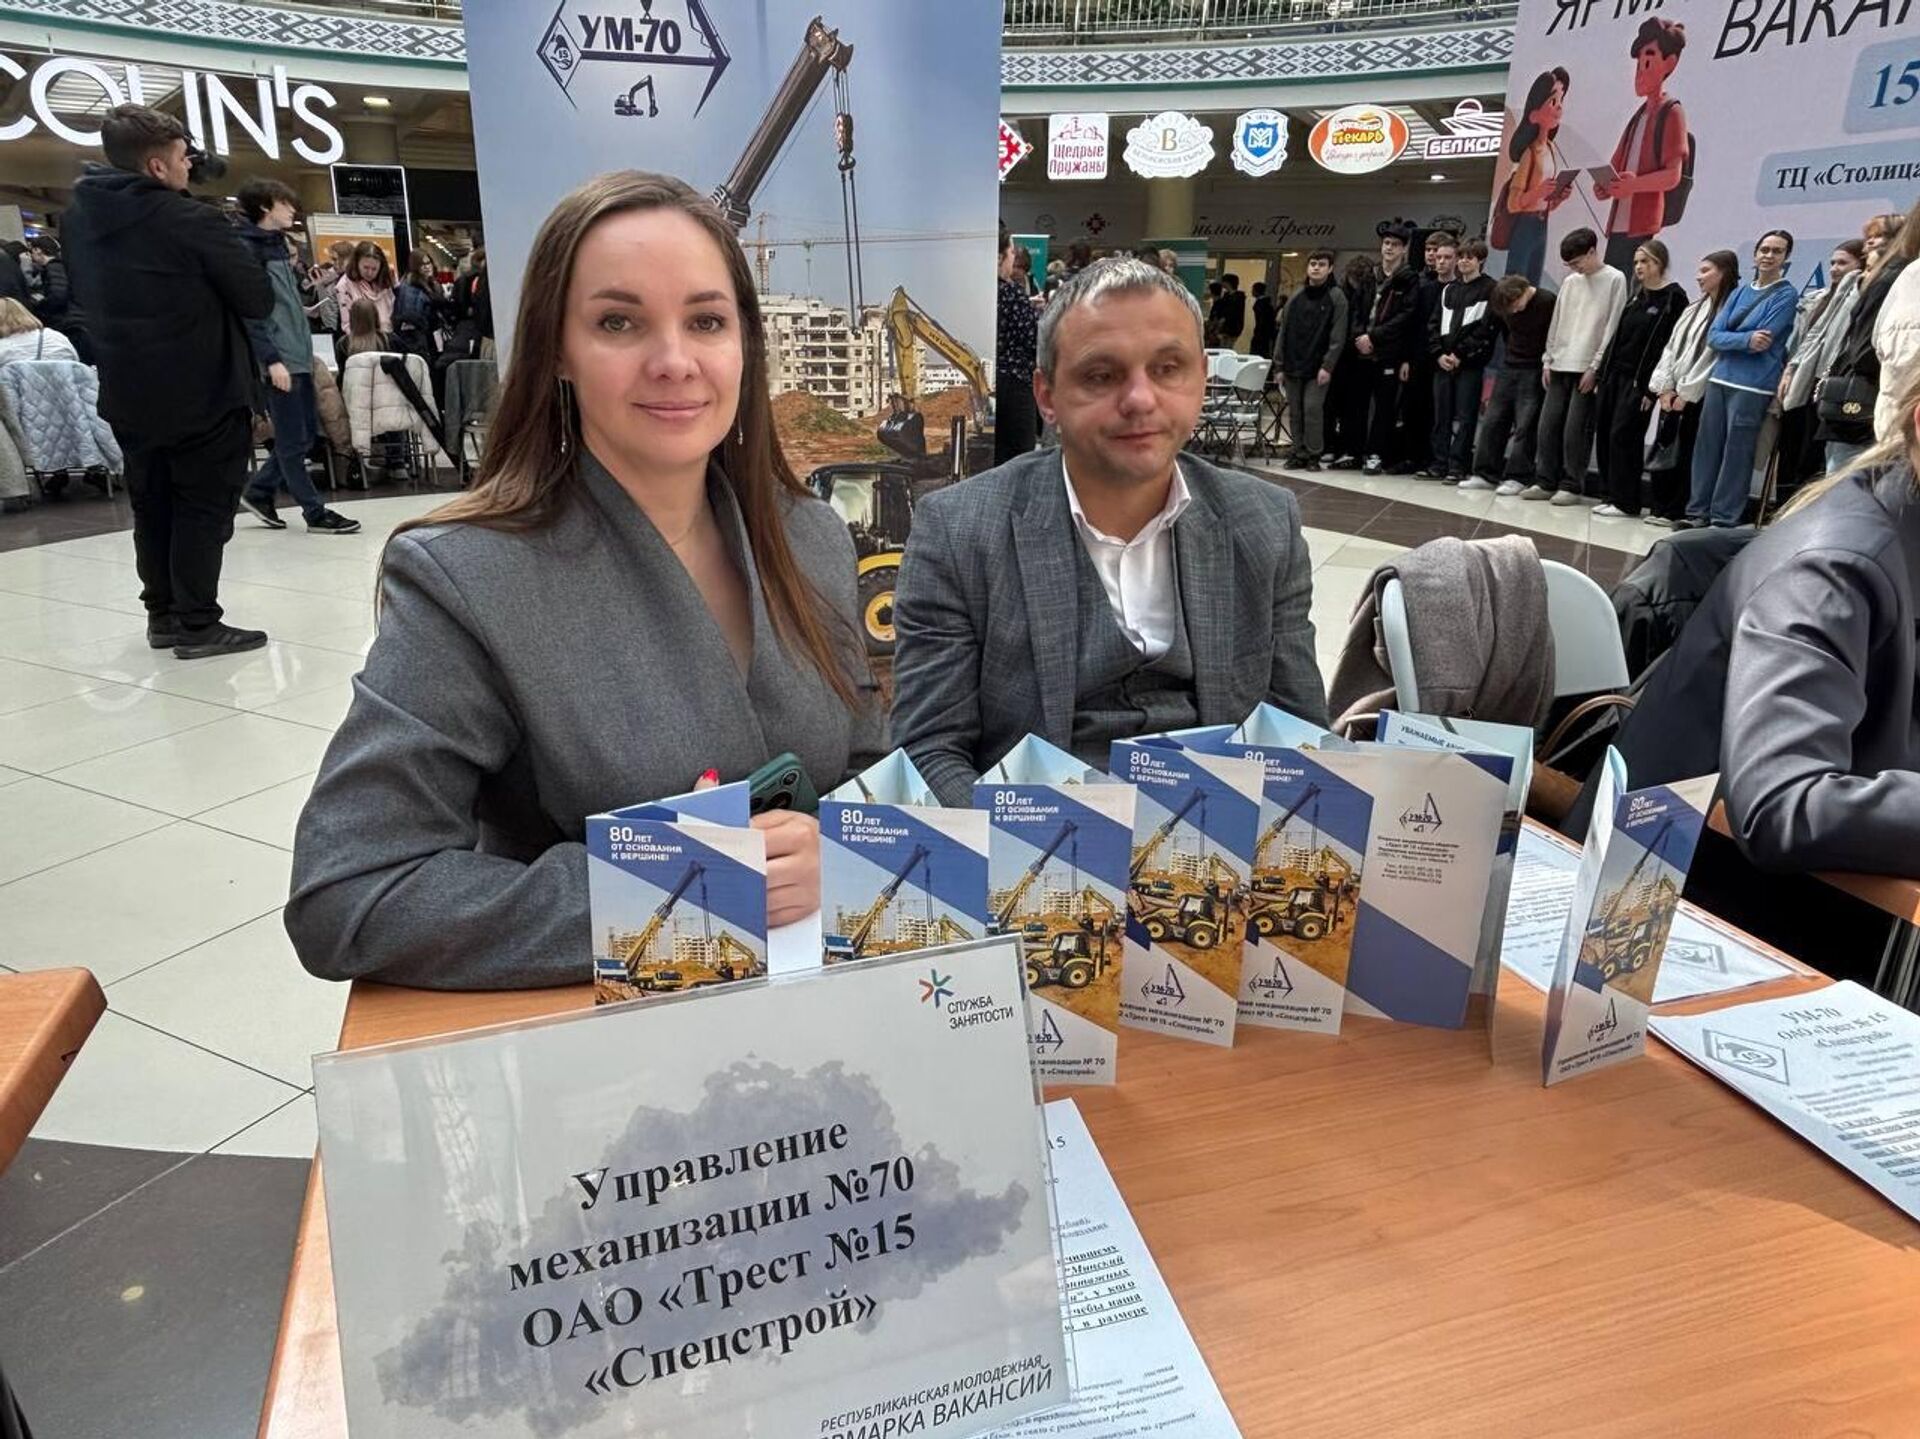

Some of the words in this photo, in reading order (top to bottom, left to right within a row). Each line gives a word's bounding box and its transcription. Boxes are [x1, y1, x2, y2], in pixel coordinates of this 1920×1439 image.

[577, 14, 682, 54] УМ-70
[1868, 60, 1920, 109] 15
[1049, 159, 1106, 177] Пружаны
[1777, 166, 1810, 191] ТЦ
[1261, 216, 1336, 244] Брест
[1130, 751, 1150, 766] 80
[1130, 765, 1141, 773] ОТ
[995, 790, 1016, 806] 80
[841, 809, 863, 824] 80
[995, 805, 1006, 814] ОТ
[609, 826, 633, 842] 80
[842, 825, 853, 833] ОТ
[611, 843, 623, 851] ОТ
[947, 995, 994, 1015] СЛУЖБА
[949, 1006, 1014, 1030] ЗАНЯТОСТИ
[1214, 1019, 1225, 1028] 70
[1094, 1057, 1106, 1066] 70
[572, 1122, 849, 1211] Управление
[507, 1190, 811, 1292] механизации
[824, 1156, 914, 1211] №70
[523, 1286, 643, 1348] ОАО
[658, 1249, 811, 1312] «Трест
[824, 1213, 916, 1269] №15
[1073, 1302, 1105, 1315] чебы
[1099, 1306, 1149, 1328] размере
[584, 1289, 878, 1396] «Спецстрой»
[820, 1409, 926, 1439] МАРКА
[934, 1363, 1053, 1427] ВАКАНСИЙ
[821, 1383, 950, 1433] РЕСПУБЛИКАНСКАЯ
[953, 1354, 1043, 1395] МОЛОДЕЖНАЯ
